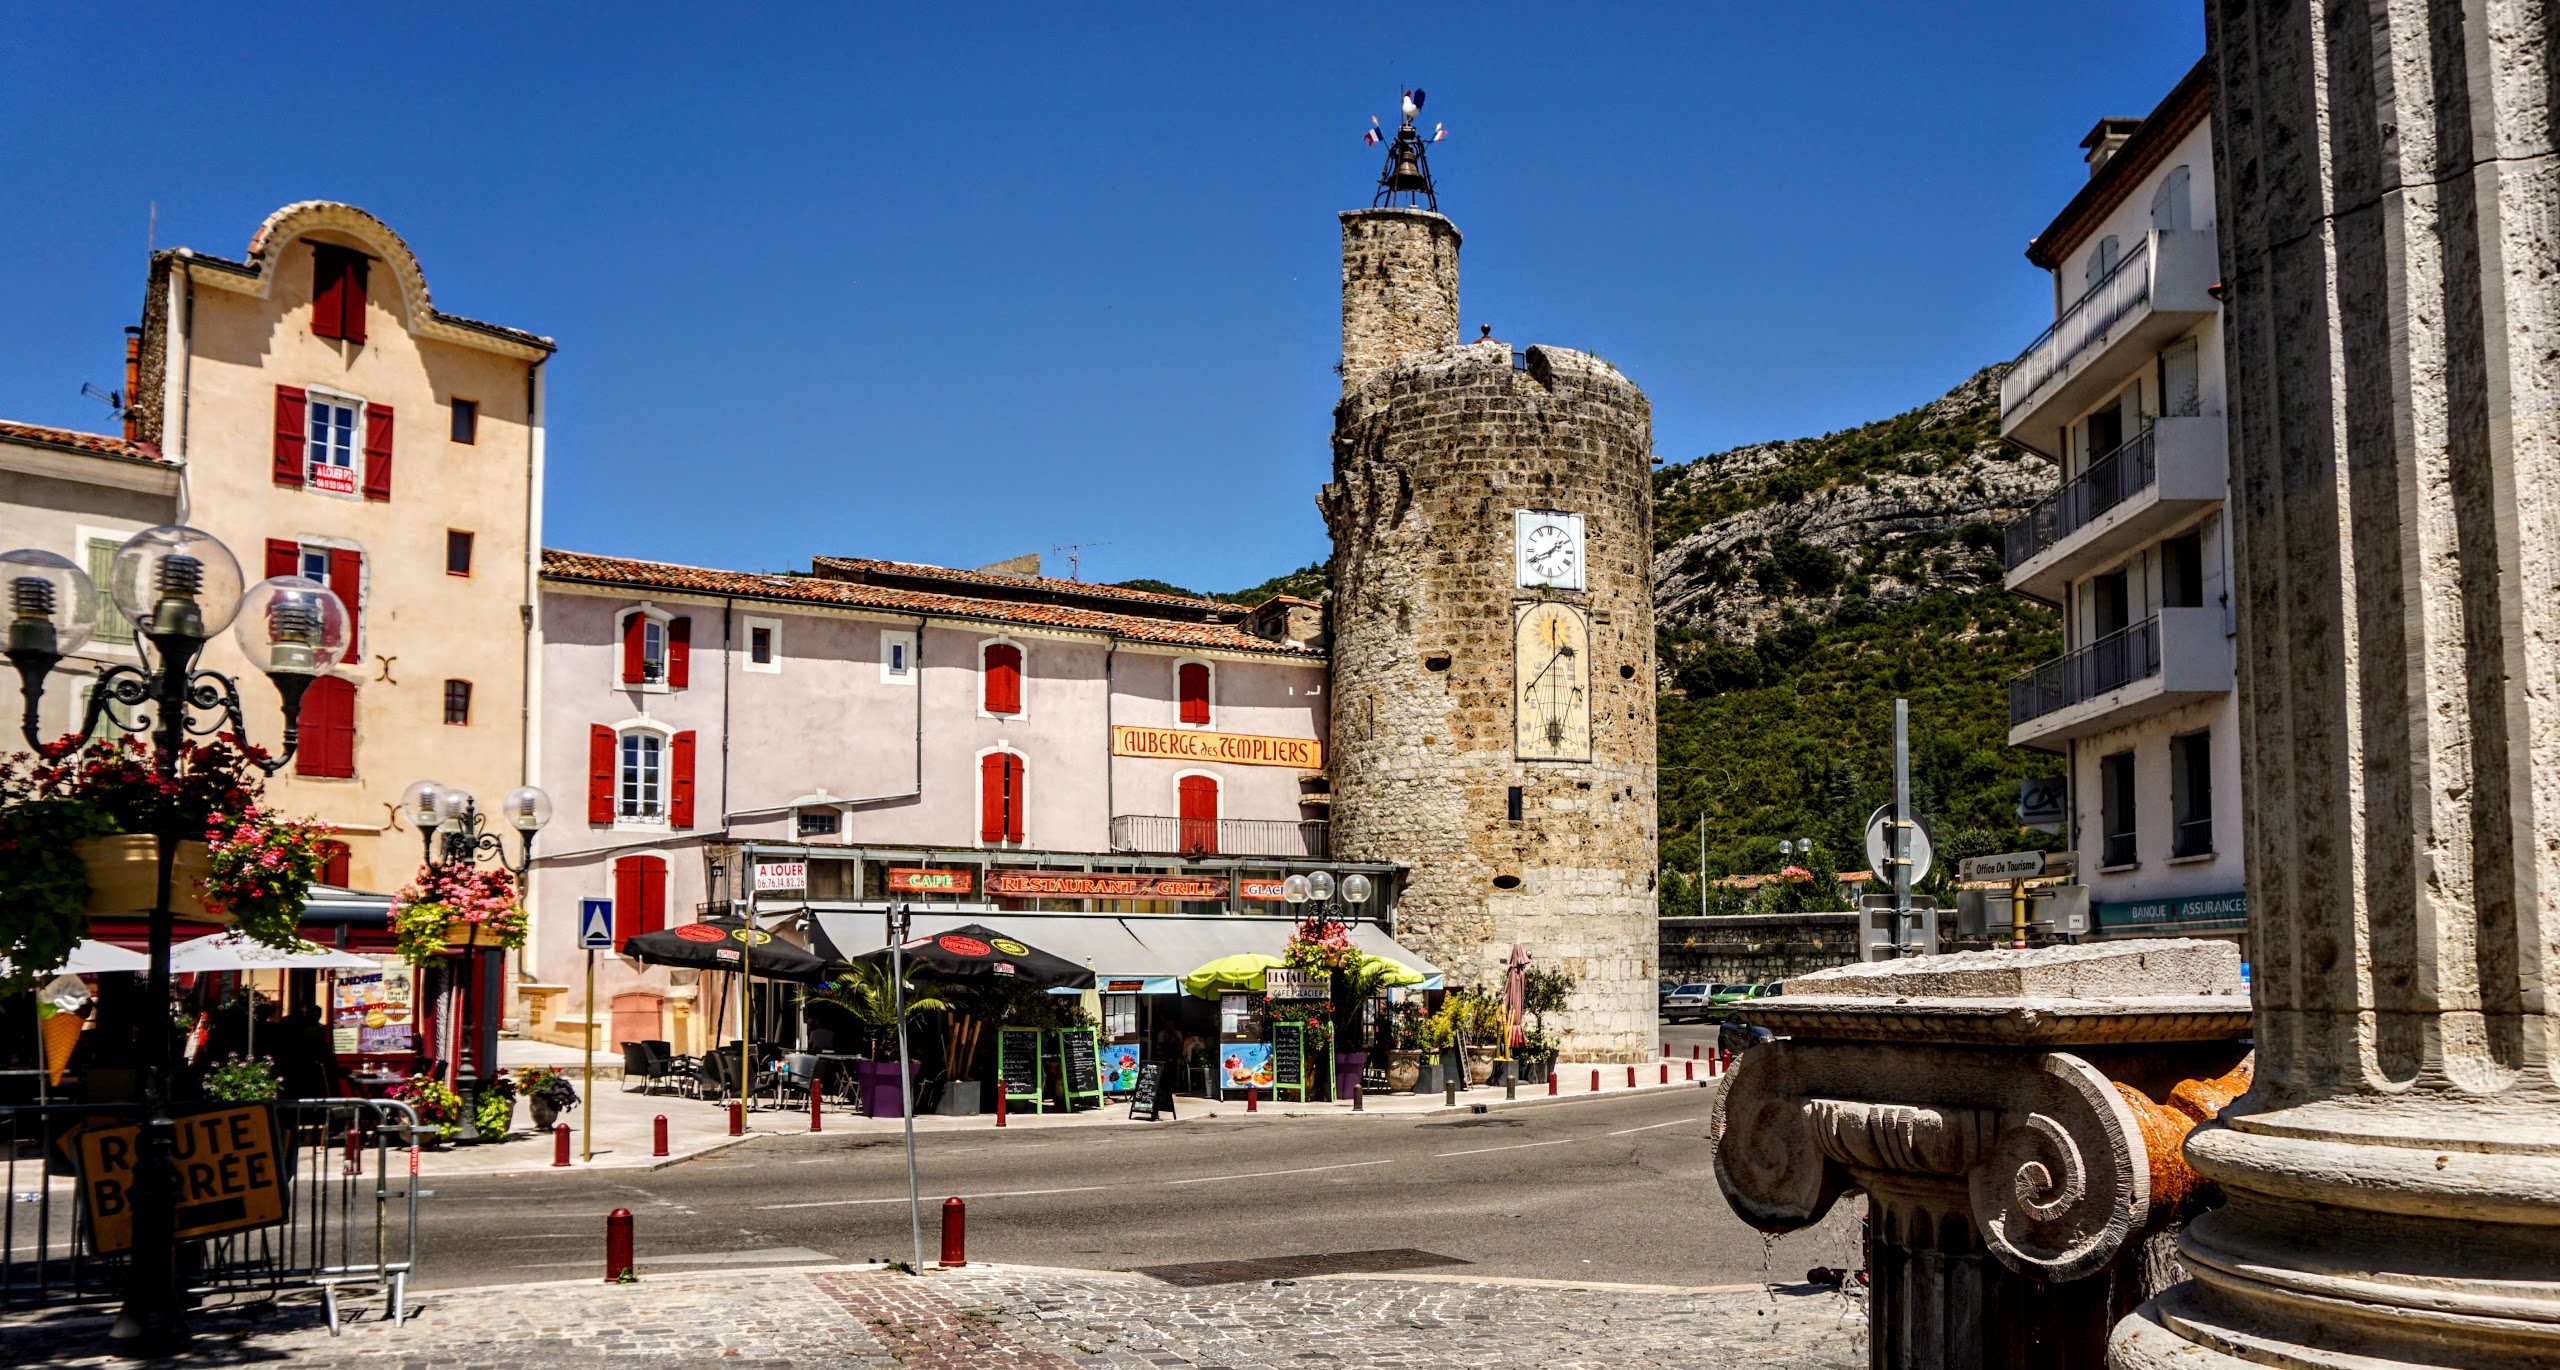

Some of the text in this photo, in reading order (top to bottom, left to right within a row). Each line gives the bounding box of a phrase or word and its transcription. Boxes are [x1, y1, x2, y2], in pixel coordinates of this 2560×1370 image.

[317, 466, 322, 476] A
[323, 466, 343, 480] LOUER
[1125, 730, 1308, 762] AUBERGE des TEMPLIERS
[760, 864, 804, 876] A LOUER
[1976, 860, 2036, 875] Office De Tourisme
[757, 877, 805, 889] 06.76.14.82.26
[909, 874, 953, 888] CAFE
[1001, 877, 1137, 894] RESTAURANT
[1157, 880, 1216, 896] GRILL
[1248, 884, 1284, 895] GLACI
[2132, 905, 2167, 919] BANQUE
[2182, 898, 2247, 915] ASSURANCES
[1295, 989, 1323, 997] GLACIER
[100, 1113, 254, 1173] RUTE
[95, 1152, 272, 1217] BRRÉE
